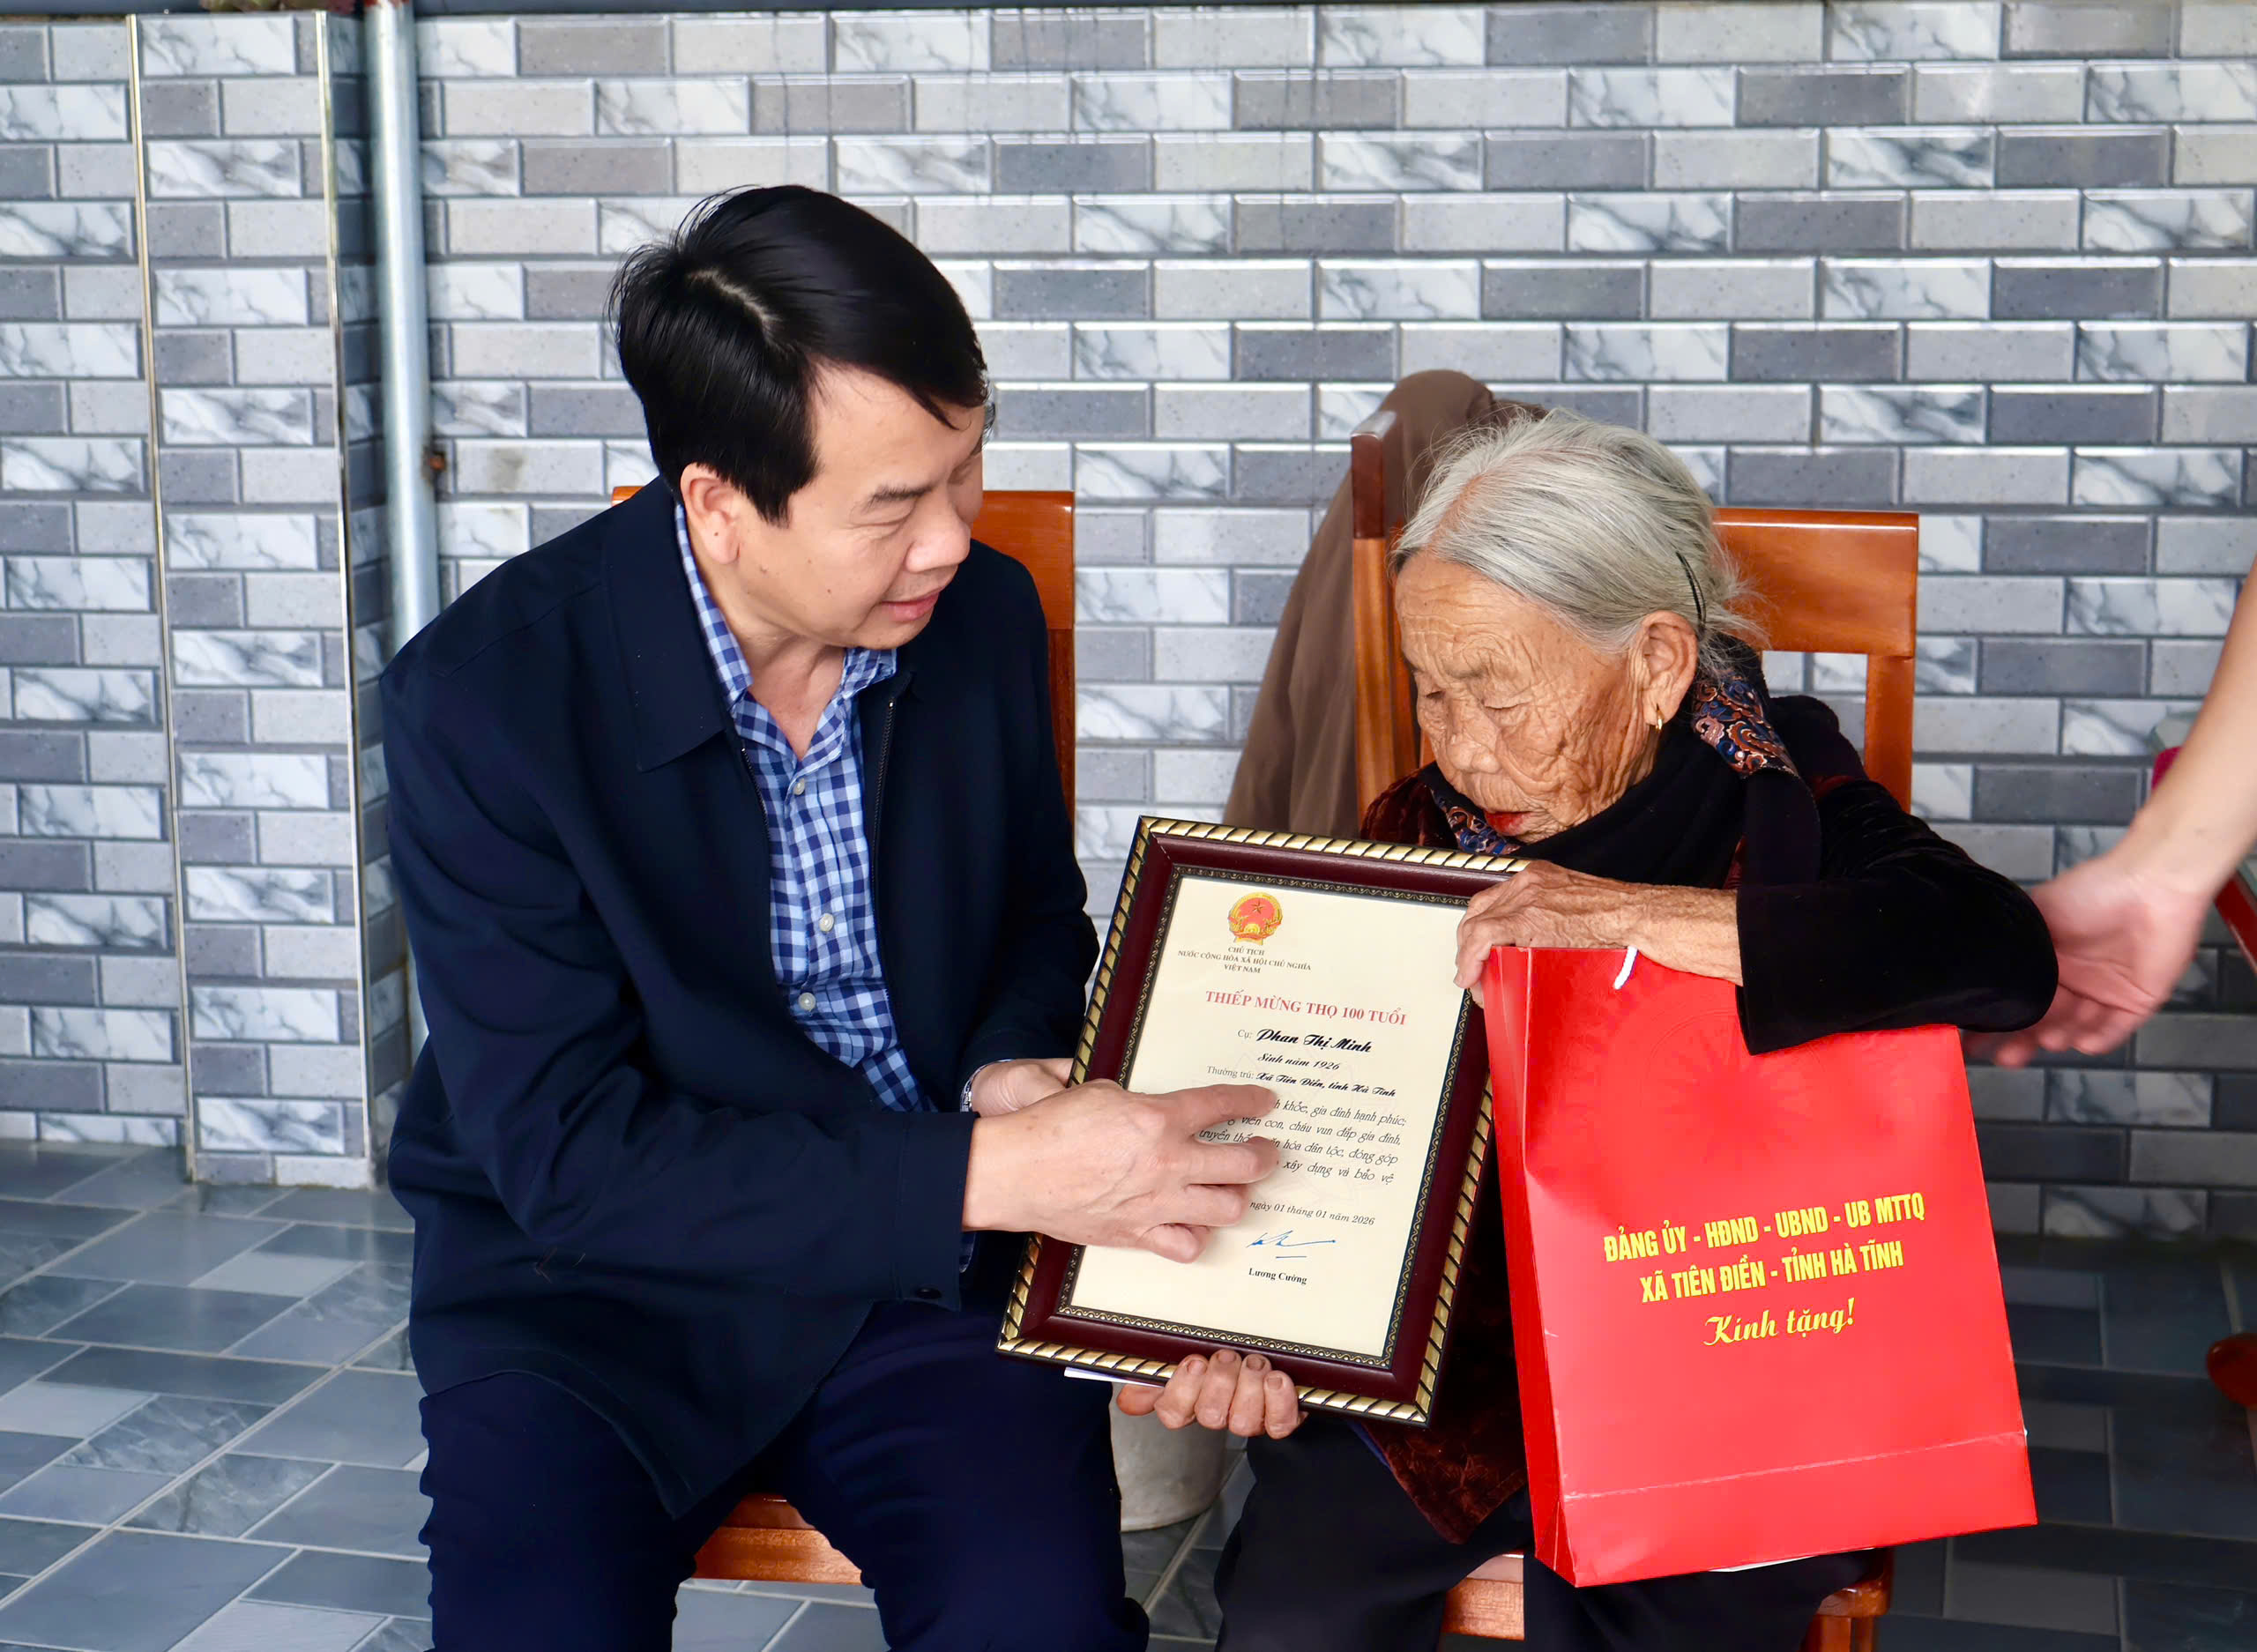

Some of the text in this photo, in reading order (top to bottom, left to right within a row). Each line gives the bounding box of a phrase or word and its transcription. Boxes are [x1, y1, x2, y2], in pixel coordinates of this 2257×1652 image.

[1205, 989, 1407, 1025] THIẾP MỪNG THỌ 100 TUỔI
[1237, 1028, 1372, 1053] Cụ: Phan Thị Minh
[1257, 1053, 1341, 1071] Sinh năm 1926
[1283, 1100, 1308, 1114] khỏe,
[1310, 1105, 1328, 1118] gia
[1330, 1106, 1352, 1119] đình
[1353, 1109, 1377, 1122] hạnh
[1376, 1113, 1406, 1127] phúc;
[1233, 1133, 1253, 1143] thố
[1283, 1159, 1303, 1172] xây
[1307, 1162, 1333, 1178] dựng
[1338, 1167, 1350, 1177] và
[1353, 1168, 1375, 1180] bảo
[1381, 1173, 1395, 1185] vệ
[1249, 1202, 1375, 1226] ngày 01 tháng 01 năm 2026
[1603, 1225, 1659, 1262] ĐẢNG
[1661, 1219, 1687, 1254] ỦY
[1704, 1216, 1760, 1248] HĐND
[1775, 1206, 1829, 1239] UBND
[1844, 1200, 1872, 1228] UB
[1874, 1192, 1926, 1224] MTTQ
[1248, 1268, 1307, 1285] Lương Cường
[1640, 1269, 1669, 1303] XÃ
[1671, 1264, 1717, 1299] TIÊN
[1719, 1254, 1766, 1292] ĐIỀN
[1781, 1246, 1828, 1283] TỈNH
[1829, 1242, 1858, 1276] HÀ
[1859, 1239, 1904, 1271] TĨNH
[1702, 1297, 1855, 1346] Kính tặng!
